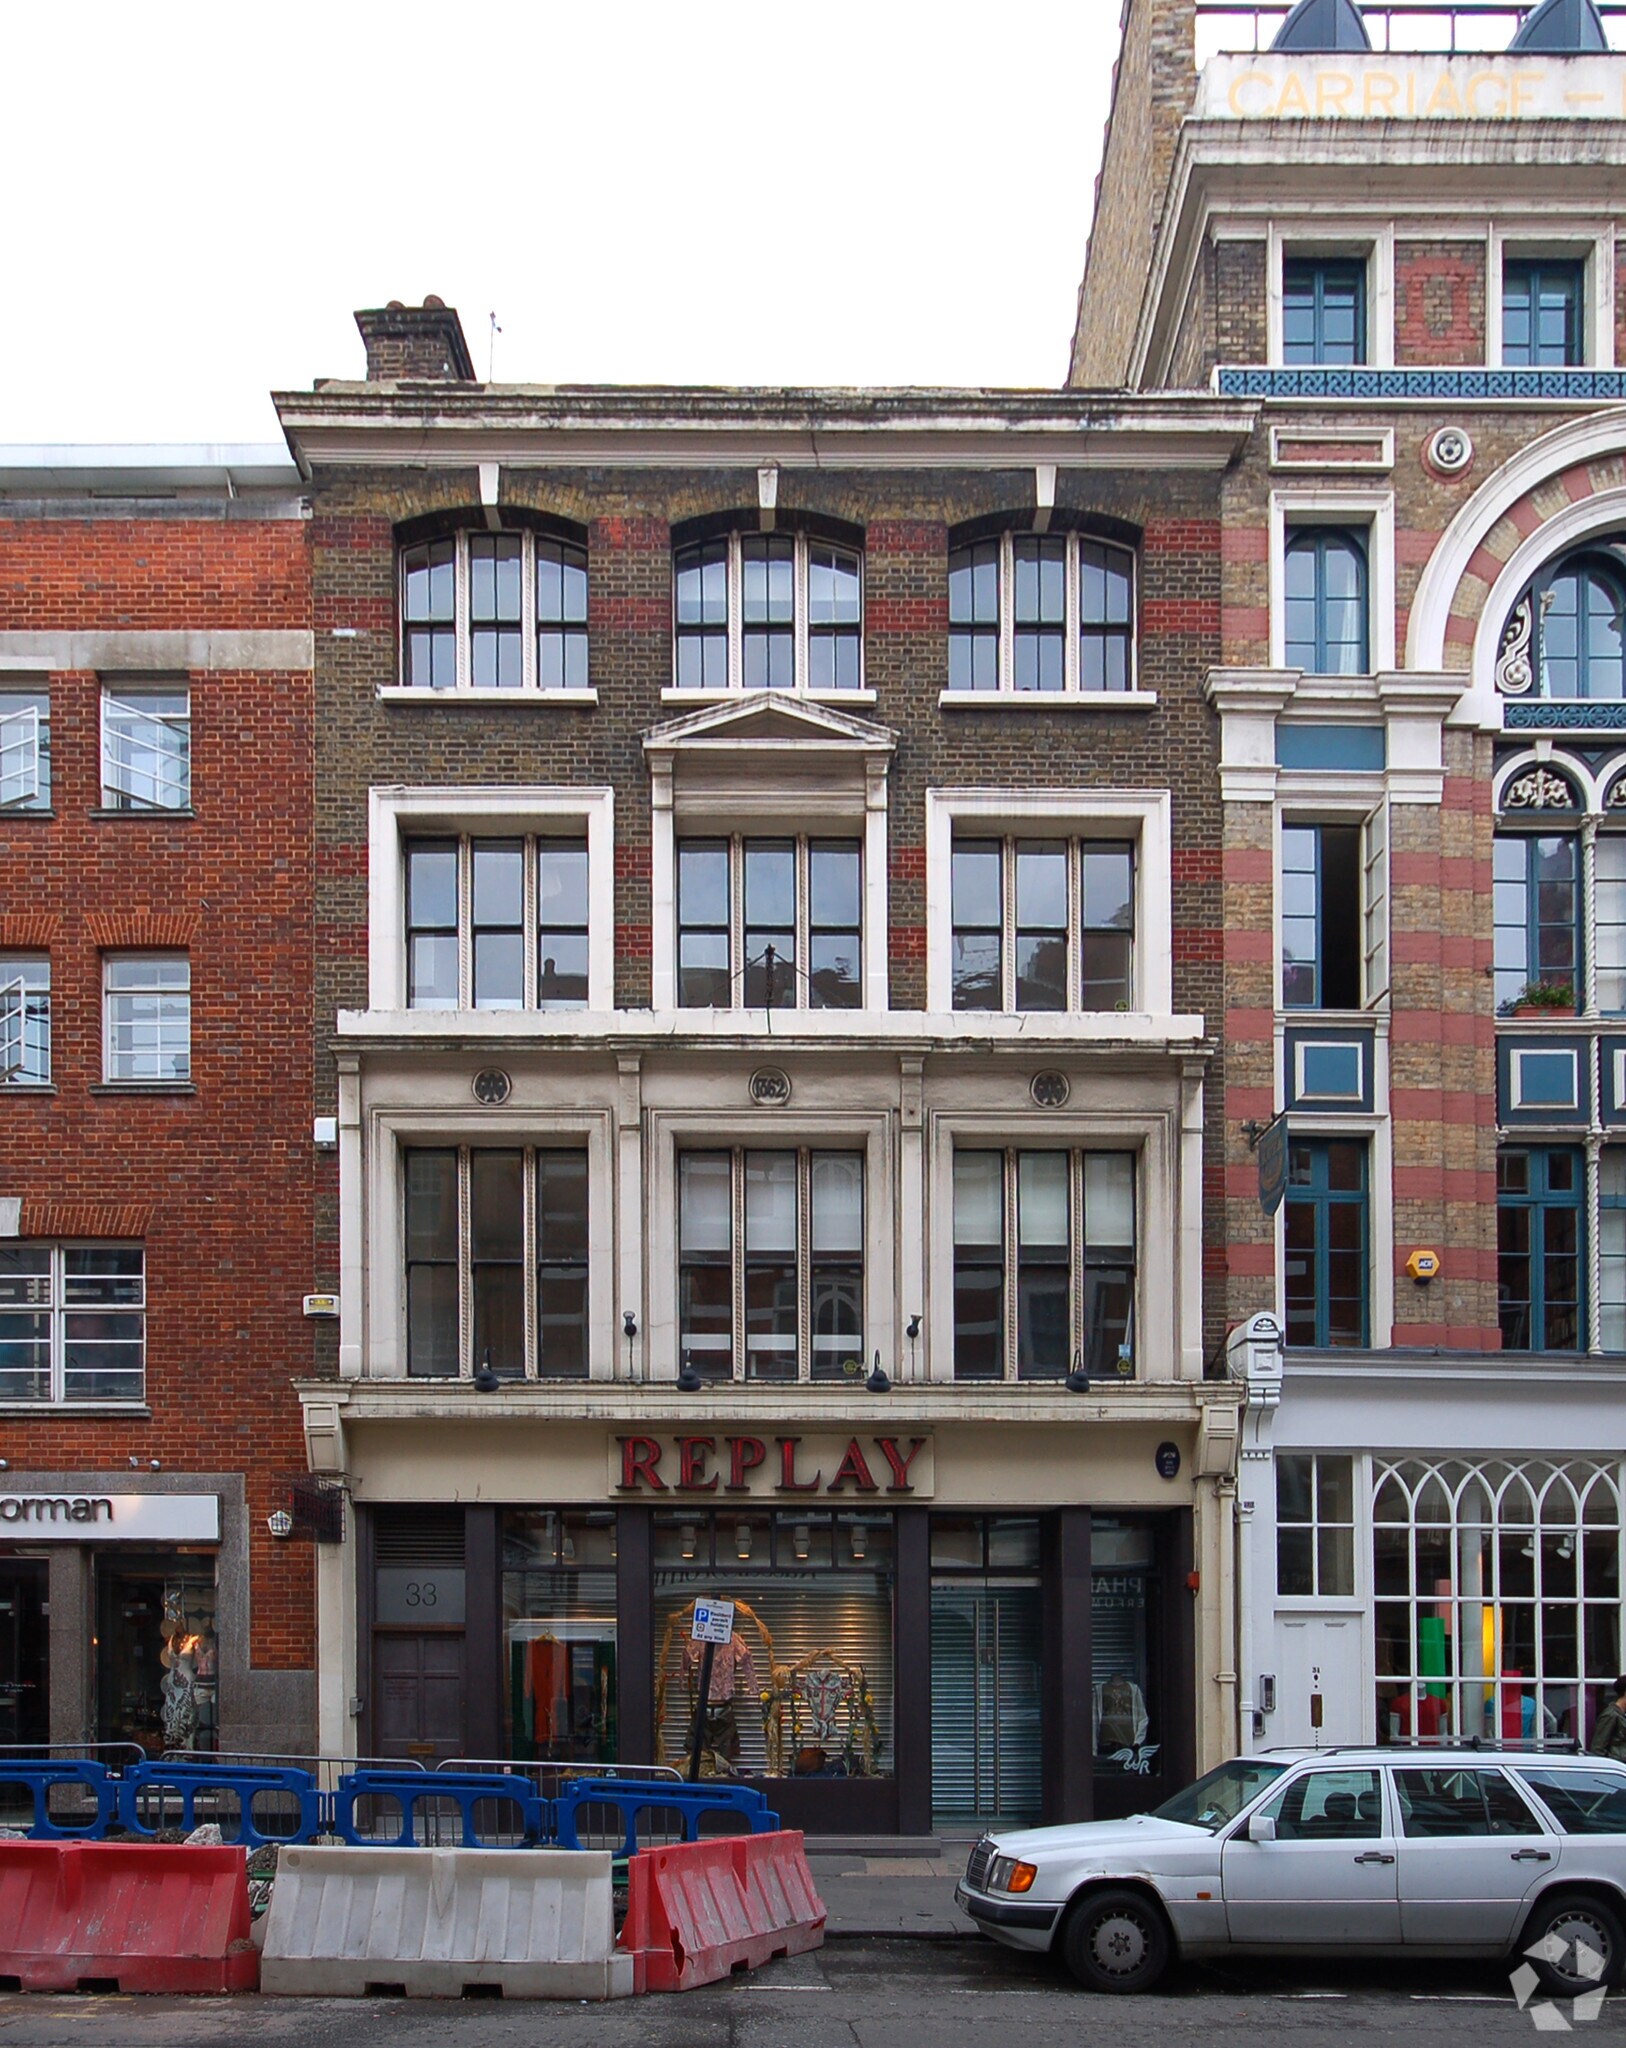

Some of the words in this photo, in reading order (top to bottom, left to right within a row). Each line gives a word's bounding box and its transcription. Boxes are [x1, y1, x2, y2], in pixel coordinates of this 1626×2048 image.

[1227, 71, 1546, 117] CARRIAGE
[615, 1436, 927, 1491] REPLAY
[0, 1498, 113, 1522] orman
[406, 1583, 437, 1606] 33
[698, 1609, 707, 1621] P
